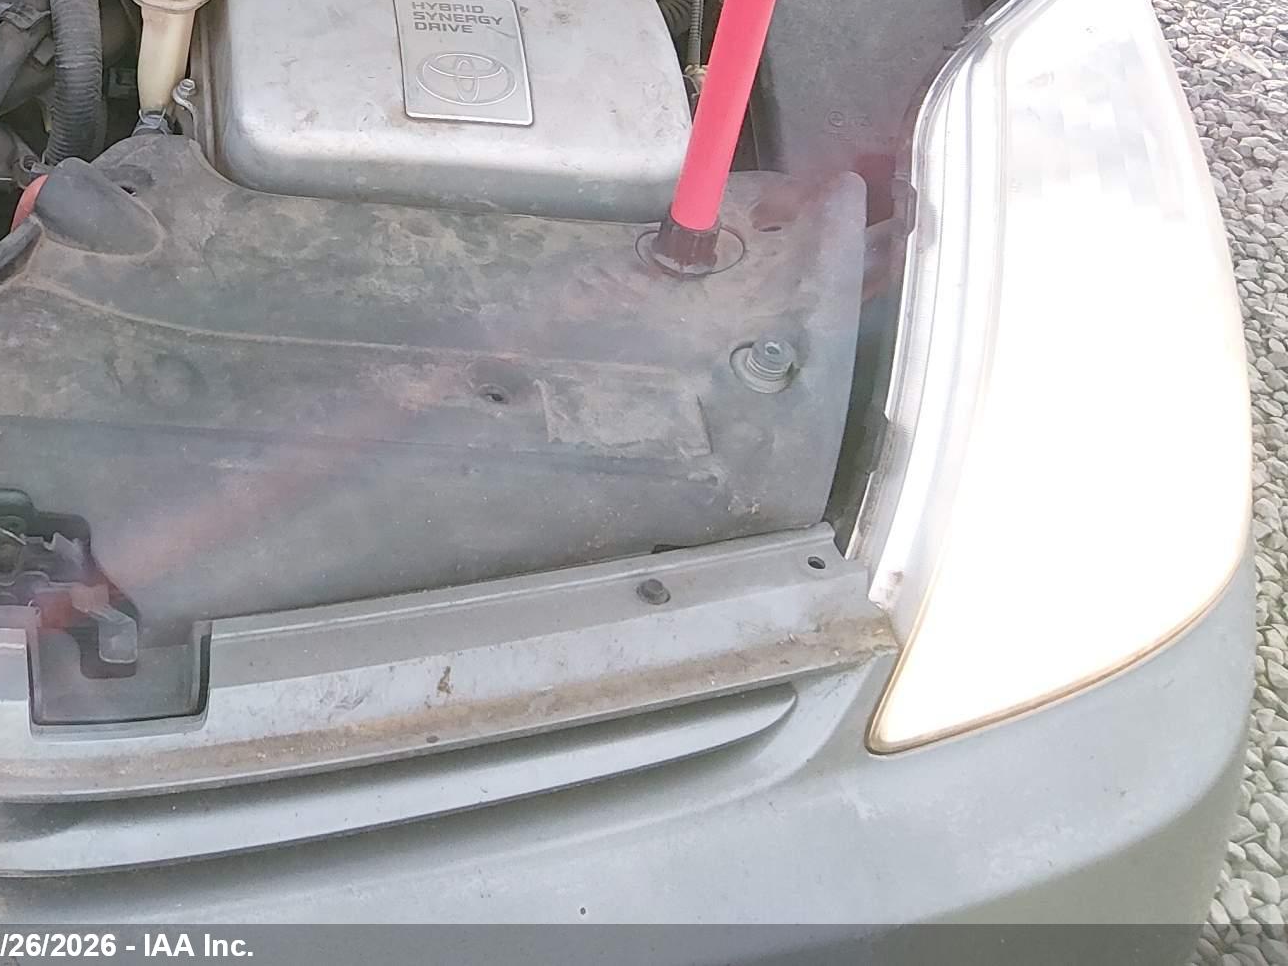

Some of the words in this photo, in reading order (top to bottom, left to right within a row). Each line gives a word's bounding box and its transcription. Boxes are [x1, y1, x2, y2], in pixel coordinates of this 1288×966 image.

[412, 1, 484, 14] HYBRID
[413, 11, 503, 26] SYNERGY
[414, 22, 473, 34] DRIVE
